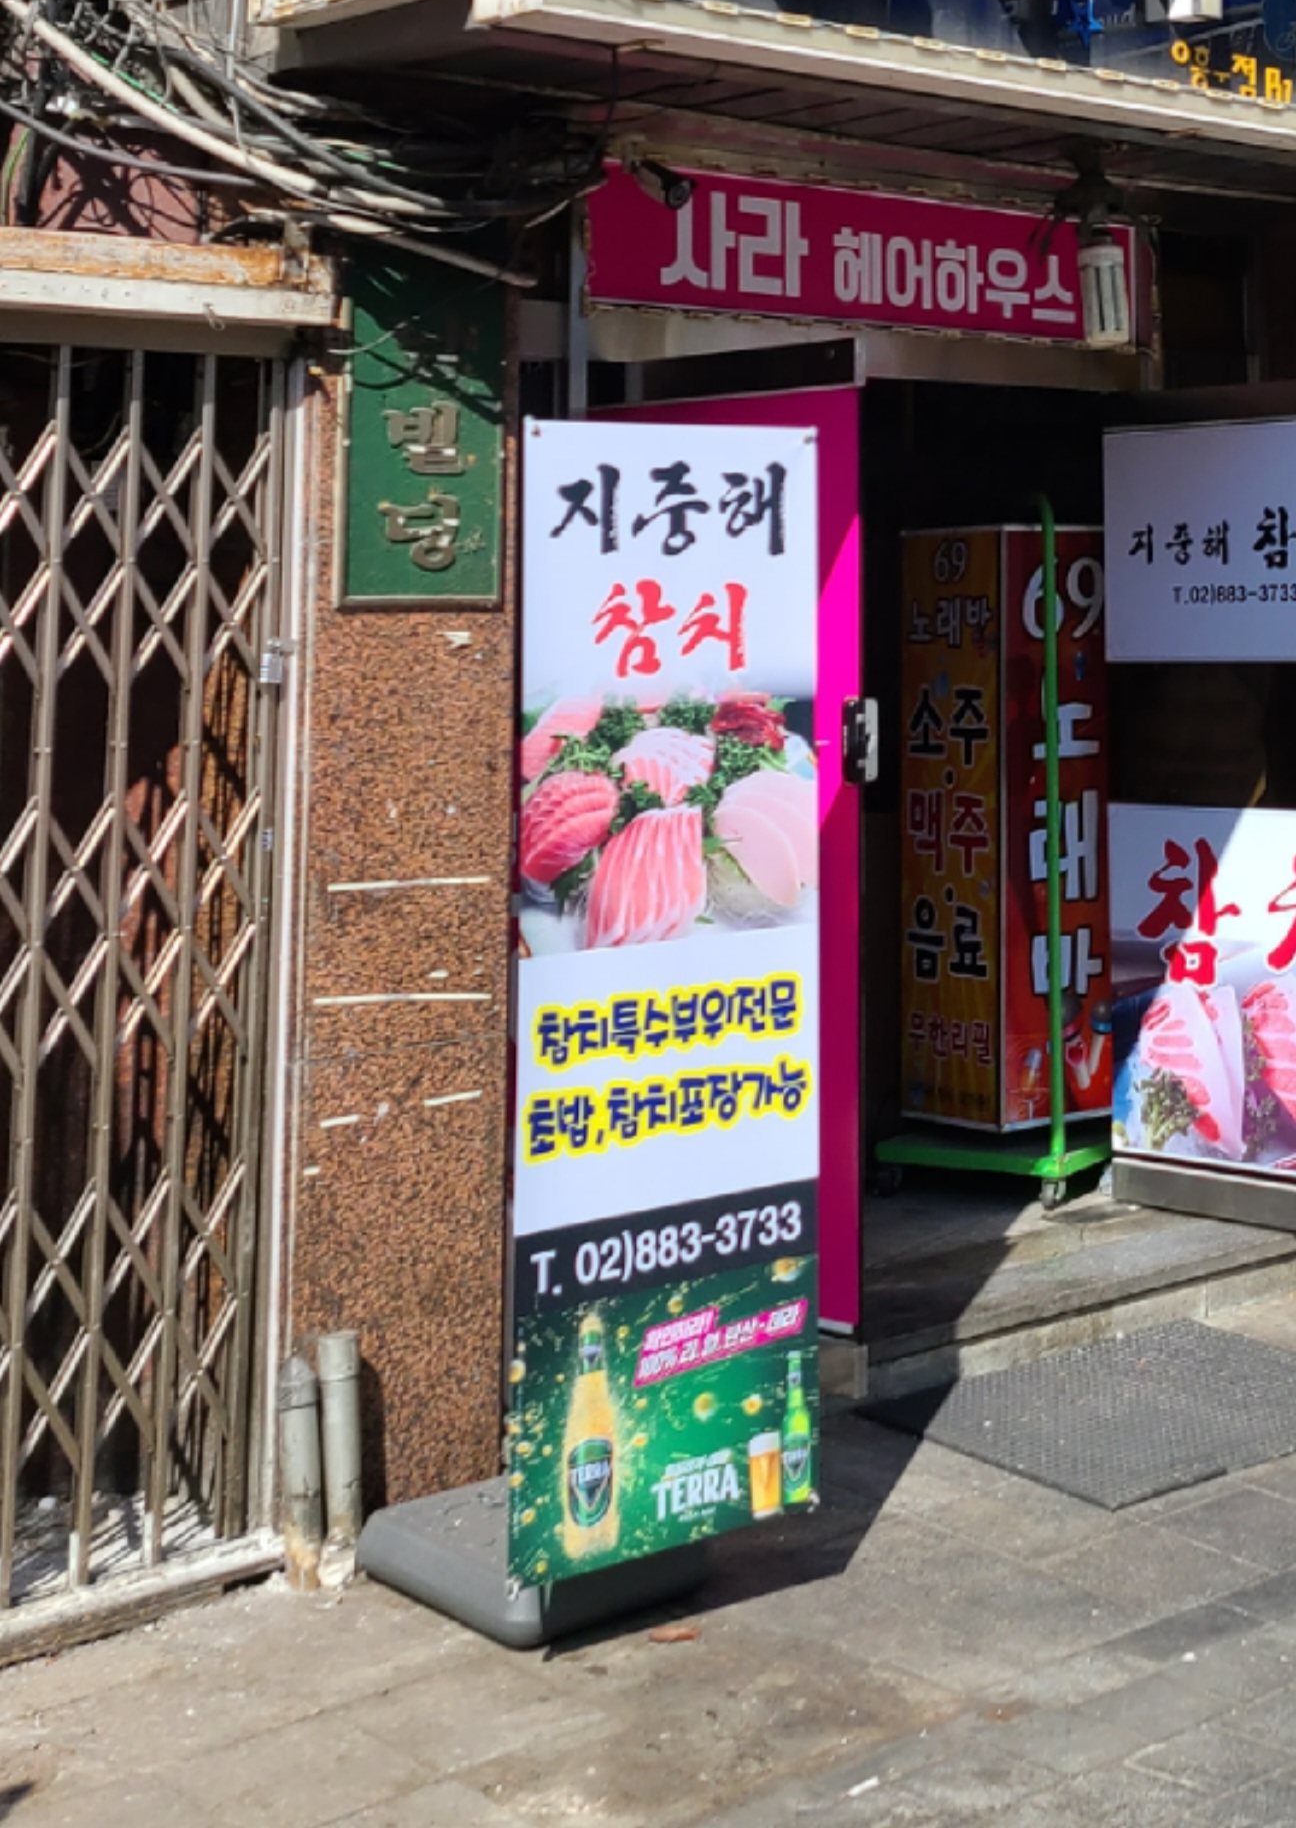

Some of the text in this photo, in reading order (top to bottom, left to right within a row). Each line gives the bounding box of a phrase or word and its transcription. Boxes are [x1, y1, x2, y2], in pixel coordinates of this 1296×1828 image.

[659, 189, 1078, 325] 사라 헤어하우스
[549, 460, 787, 556] 지중해
[1128, 519, 1231, 567] 지중해
[933, 541, 968, 583] 69
[1021, 555, 1105, 640] 69
[591, 578, 749, 678] 참치
[907, 684, 990, 770] 소주
[906, 788, 991, 878] 맥주
[905, 894, 989, 983] 음료
[907, 1012, 992, 1066] 무한리필
[529, 1200, 803, 1297] T. 02)883-3733
[650, 1463, 742, 1522] TERRA
